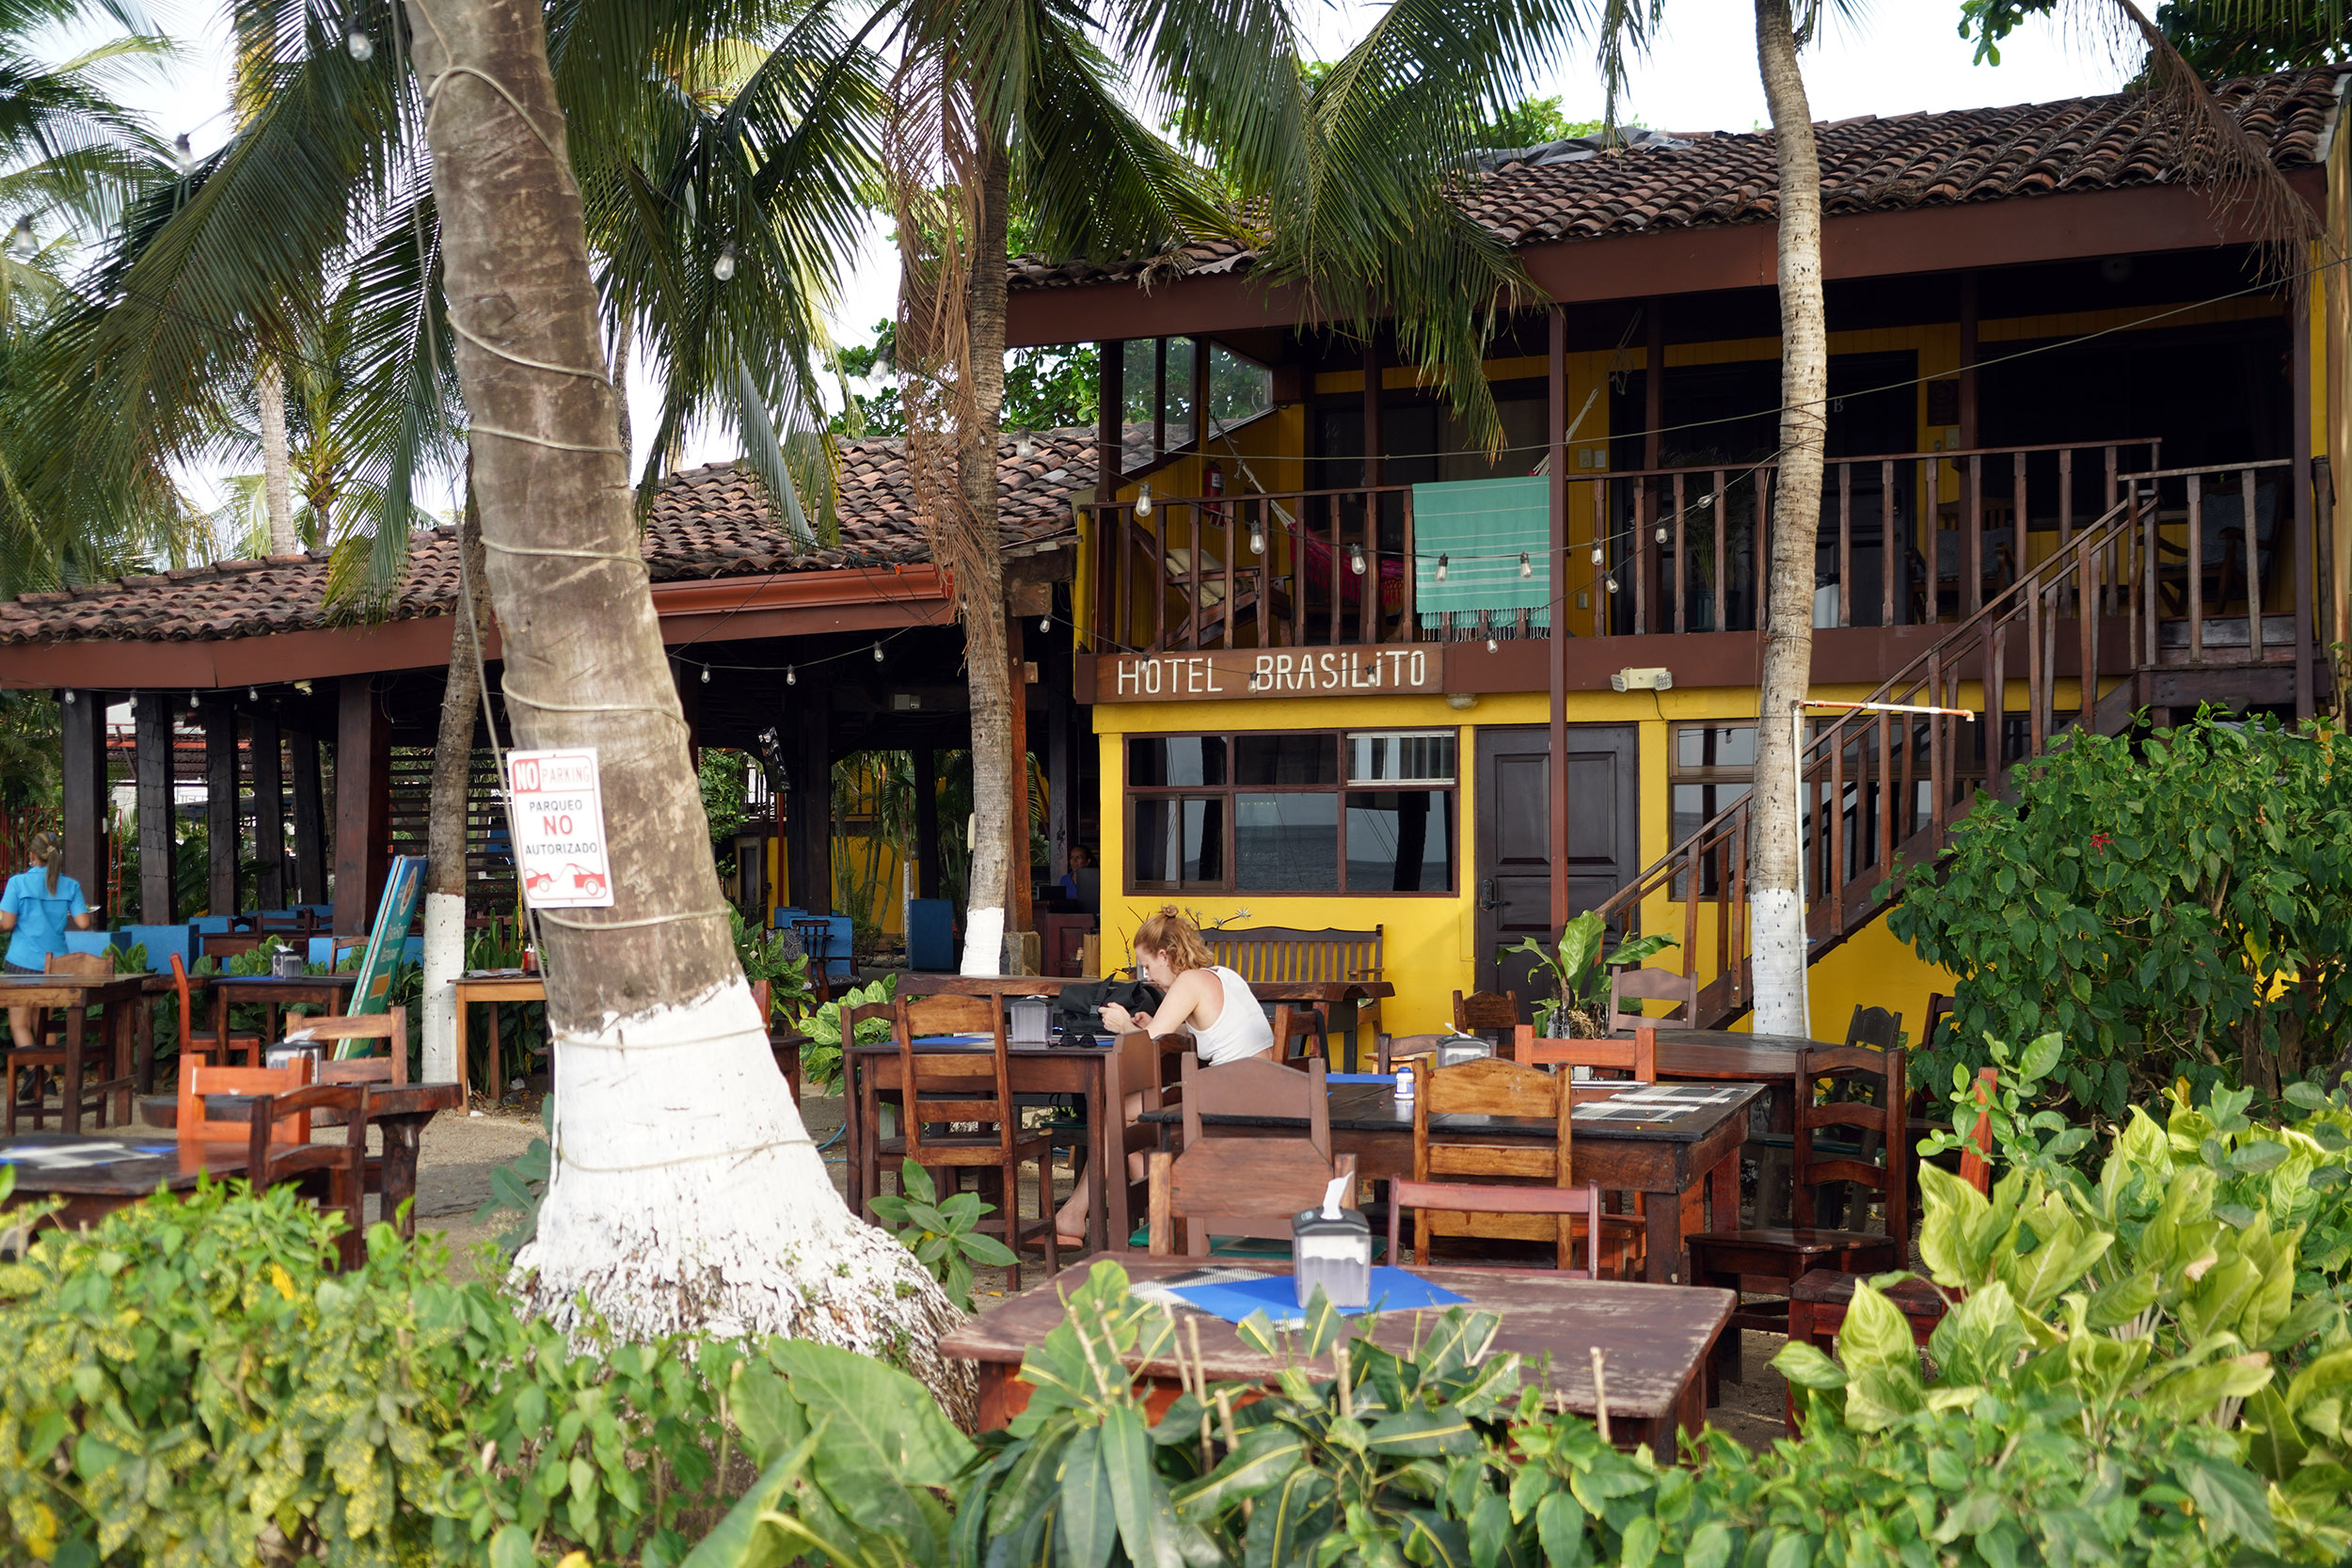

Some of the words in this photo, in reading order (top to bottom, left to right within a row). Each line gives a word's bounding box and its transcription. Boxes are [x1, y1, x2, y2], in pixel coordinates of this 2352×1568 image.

[1117, 657, 1223, 695] HOTEL
[515, 761, 540, 791] NO
[541, 766, 591, 782] PARKING
[529, 799, 582, 813] PARQUEO
[543, 815, 573, 836] NO
[525, 842, 597, 856] AUTORIZADO
